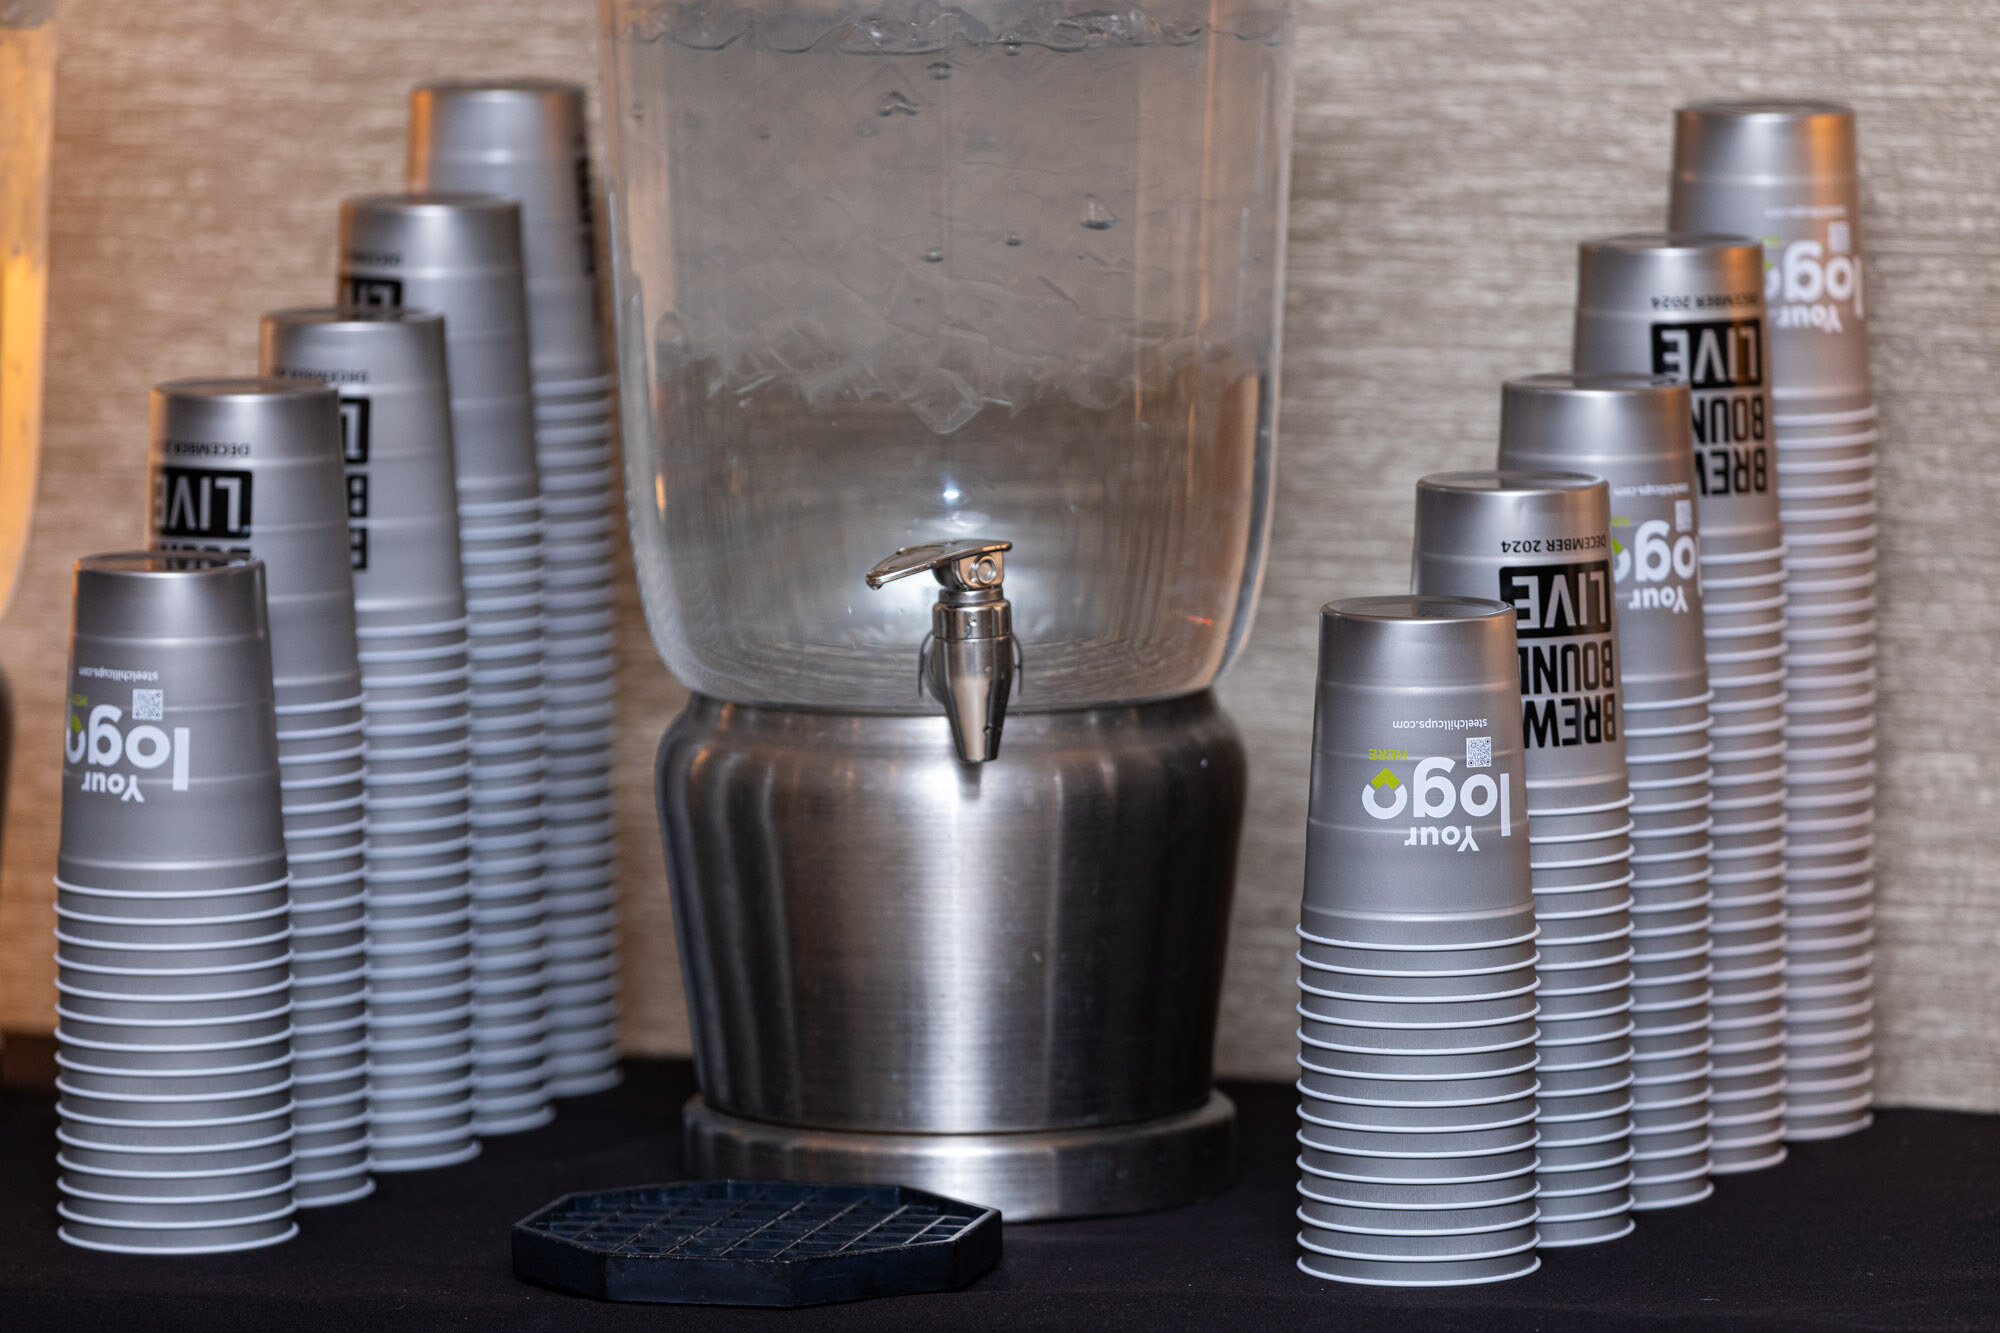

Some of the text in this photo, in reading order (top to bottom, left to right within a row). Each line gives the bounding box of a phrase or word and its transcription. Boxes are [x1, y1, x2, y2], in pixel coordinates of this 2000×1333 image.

[1776, 303, 1843, 334] Your
[1660, 325, 1757, 385] LIVE
[1692, 395, 1765, 444] BOUN
[1501, 534, 1607, 554] DECEMBER 2024
[1511, 569, 1608, 630] LIVE
[1628, 585, 1689, 614] Your
[1392, 718, 1488, 731] steelchillcups.com
[1522, 692, 1617, 750] BREW
[65, 703, 190, 792] logo
[1368, 748, 1408, 761] HERE
[80, 771, 145, 803] Your
[1361, 756, 1512, 837] logo
[1403, 825, 1480, 852] Your
